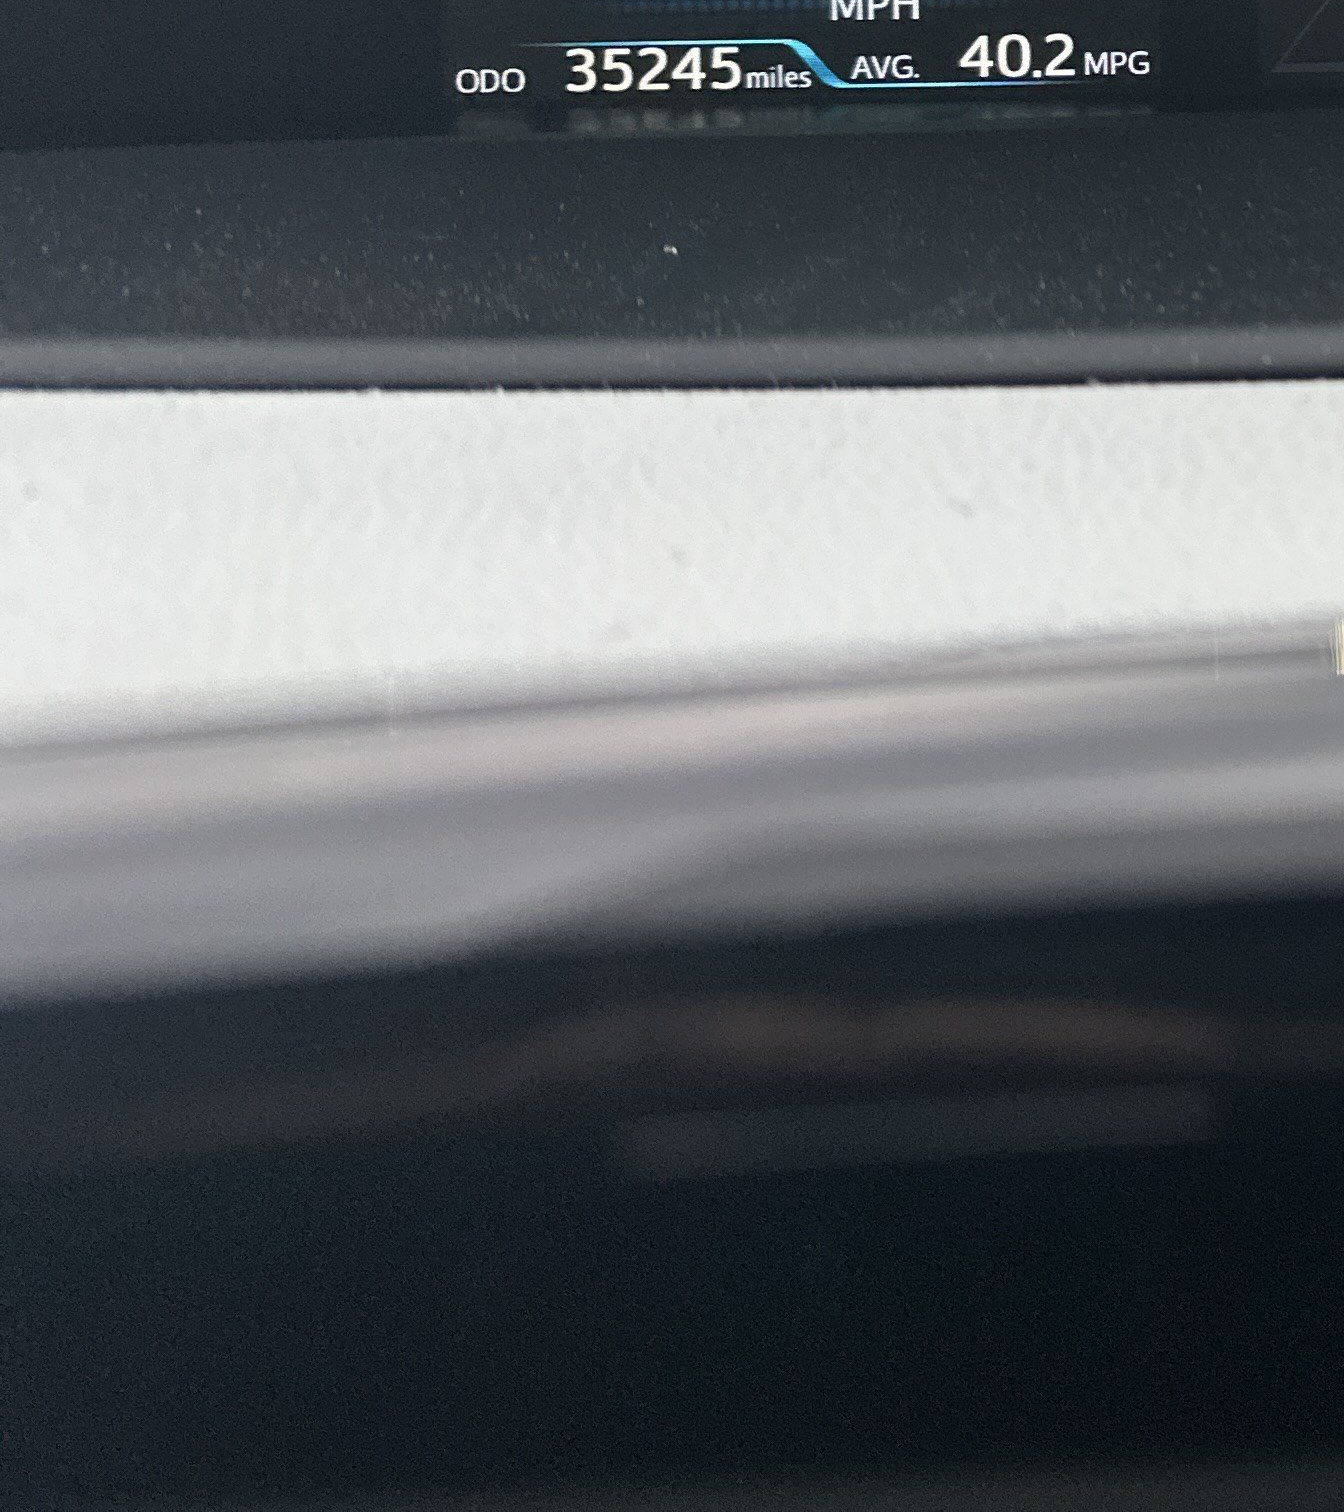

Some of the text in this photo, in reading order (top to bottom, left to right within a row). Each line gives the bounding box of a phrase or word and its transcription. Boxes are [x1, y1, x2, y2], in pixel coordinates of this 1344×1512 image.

[456, 48, 812, 93] ODO 35245 miles
[850, 34, 1149, 79] AVG. 40.2 MPG
